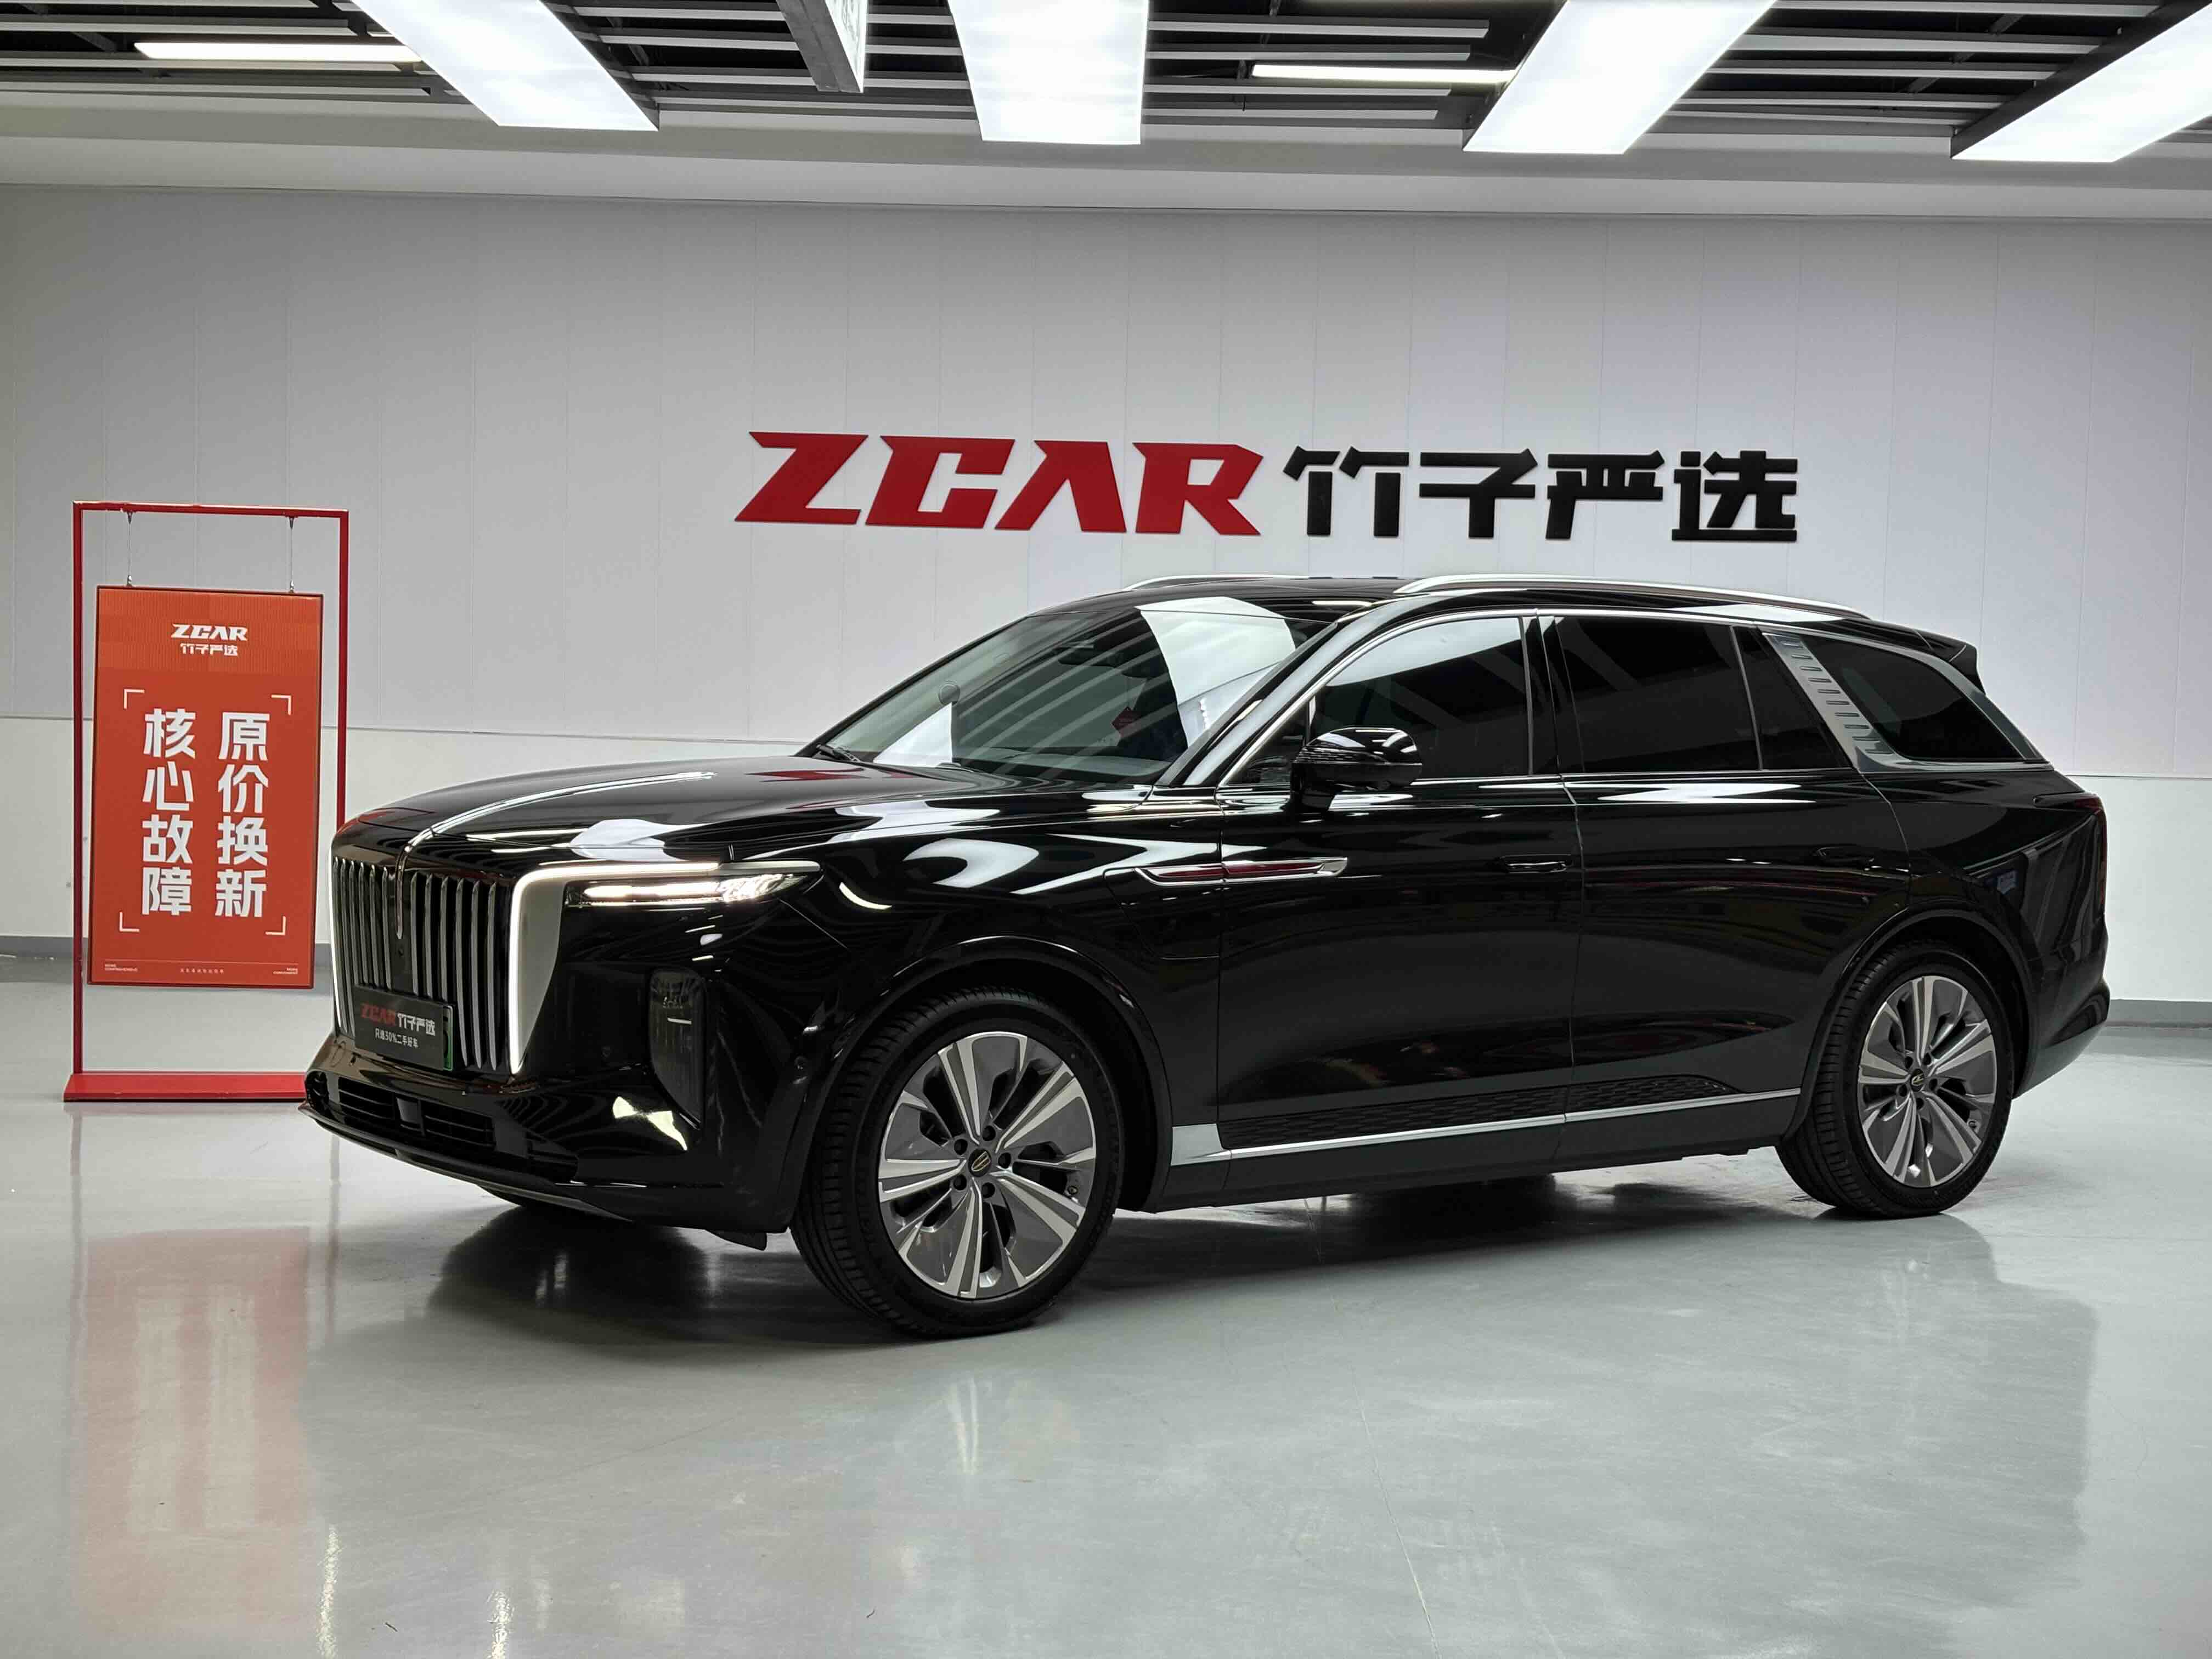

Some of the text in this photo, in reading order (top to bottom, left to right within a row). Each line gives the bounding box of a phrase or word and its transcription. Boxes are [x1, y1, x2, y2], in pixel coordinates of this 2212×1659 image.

[735, 432, 1798, 542] ZCAR 竹子严选
[171, 624, 248, 641] ZCAR
[180, 643, 238, 656] 竹子严选
[142, 708, 196, 916] 核心故障
[215, 712, 270, 918] 原价换新
[397, 1012, 436, 1036] 竹子严选
